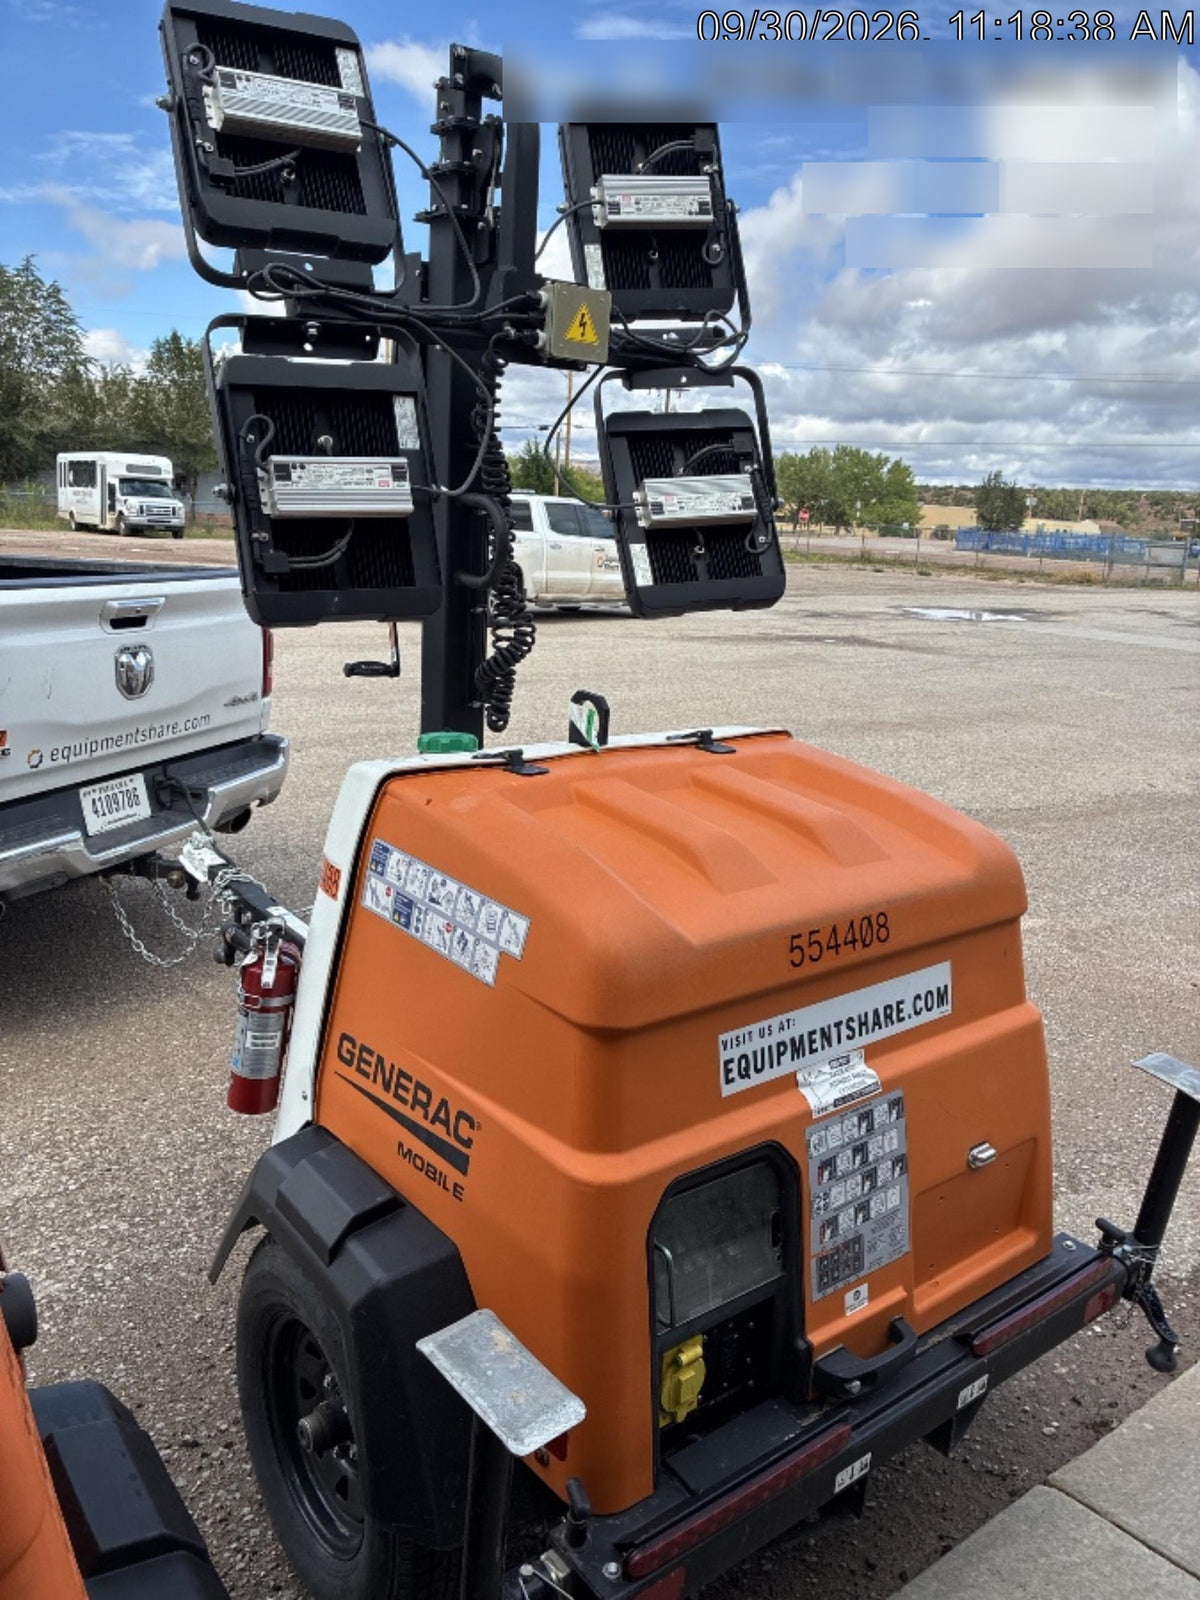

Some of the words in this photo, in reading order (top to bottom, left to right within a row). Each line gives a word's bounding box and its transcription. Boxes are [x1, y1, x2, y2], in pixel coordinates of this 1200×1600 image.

[50, 713, 210, 763] equipmentshare.com
[789, 911, 890, 968] 554408
[721, 1030, 753, 1051] VISIT
[759, 1024, 773, 1040] US
[778, 1018, 796, 1033] AT:
[723, 984, 949, 1085] EQUIPMENTSHARE.COM
[337, 1032, 475, 1149] GENERAC
[397, 1141, 465, 1202] MOBILE
